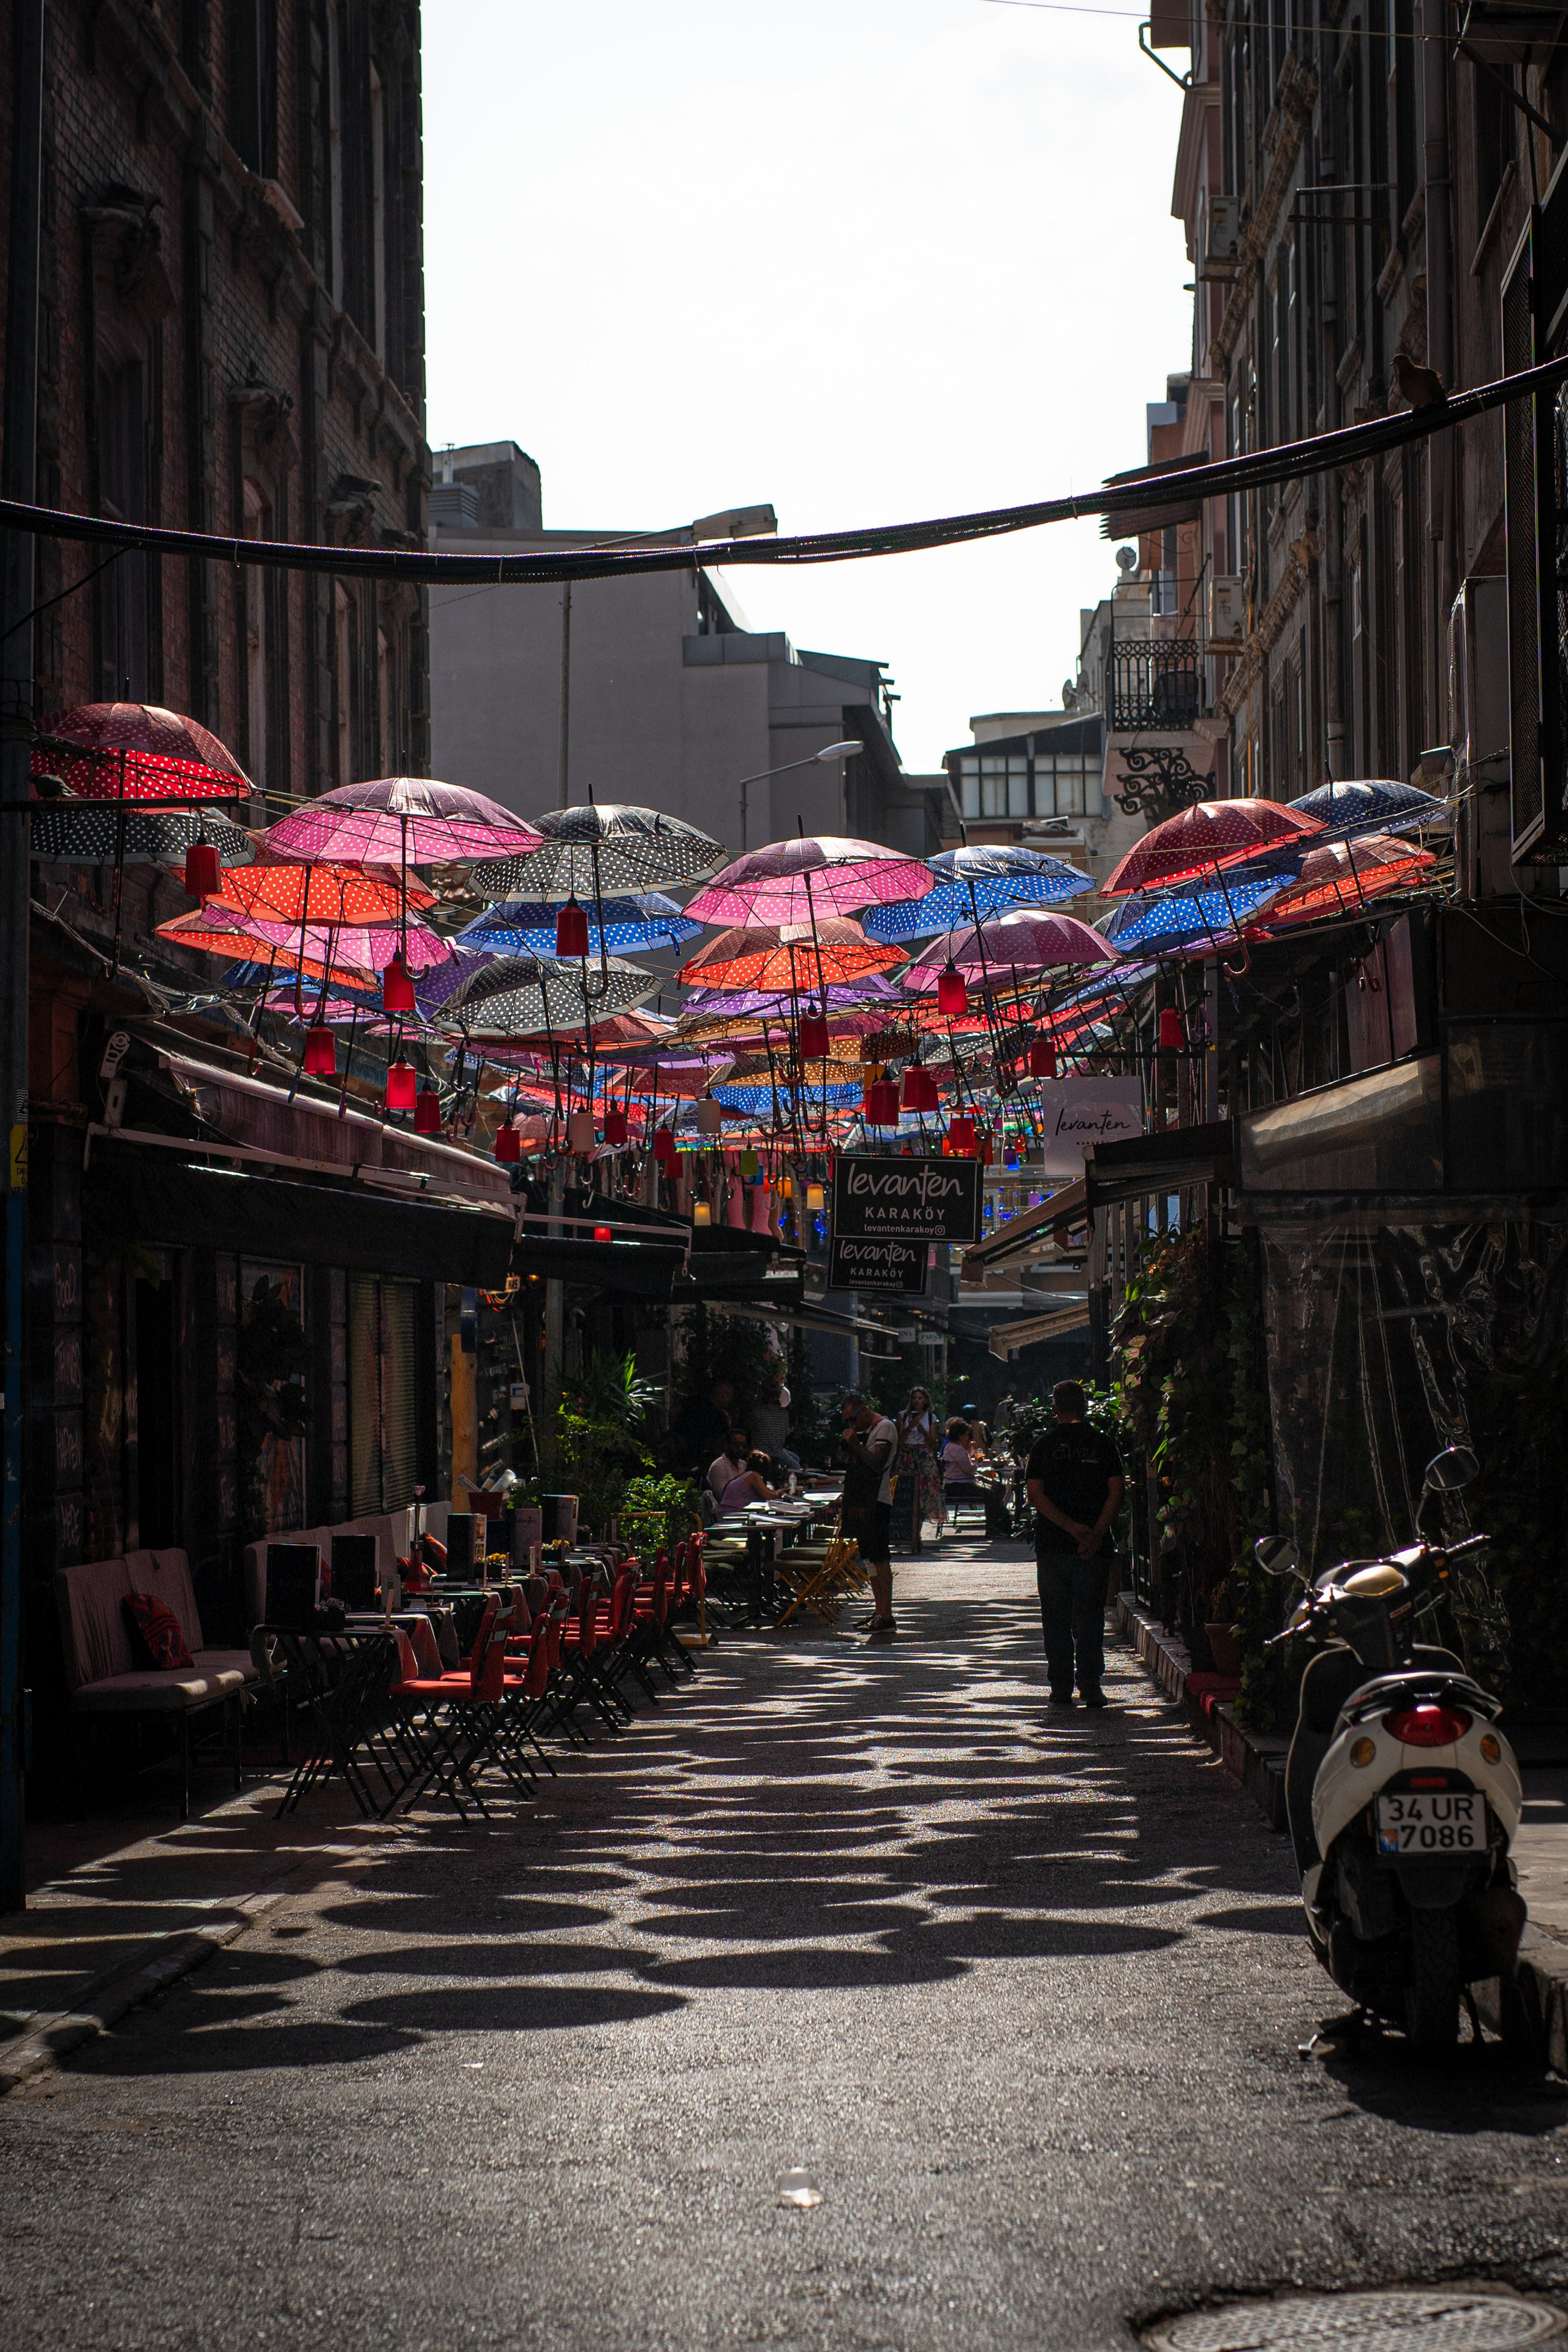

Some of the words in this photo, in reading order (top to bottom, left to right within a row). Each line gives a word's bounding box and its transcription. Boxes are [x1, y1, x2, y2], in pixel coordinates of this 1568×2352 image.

[1055, 1107, 1130, 1136] levanten
[847, 1163, 964, 1207] levanten
[865, 1207, 945, 1220] KARAKÖY
[864, 1224, 935, 1235] levantenkarakoy
[839, 1240, 916, 1268] levanten
[850, 1267, 903, 1278] KARAKÖY
[850, 1279, 896, 1288] levantenkarakoy
[1388, 1798, 1423, 1821] 34
[1432, 1798, 1474, 1821] UR
[1401, 1825, 1474, 1850] 7086
